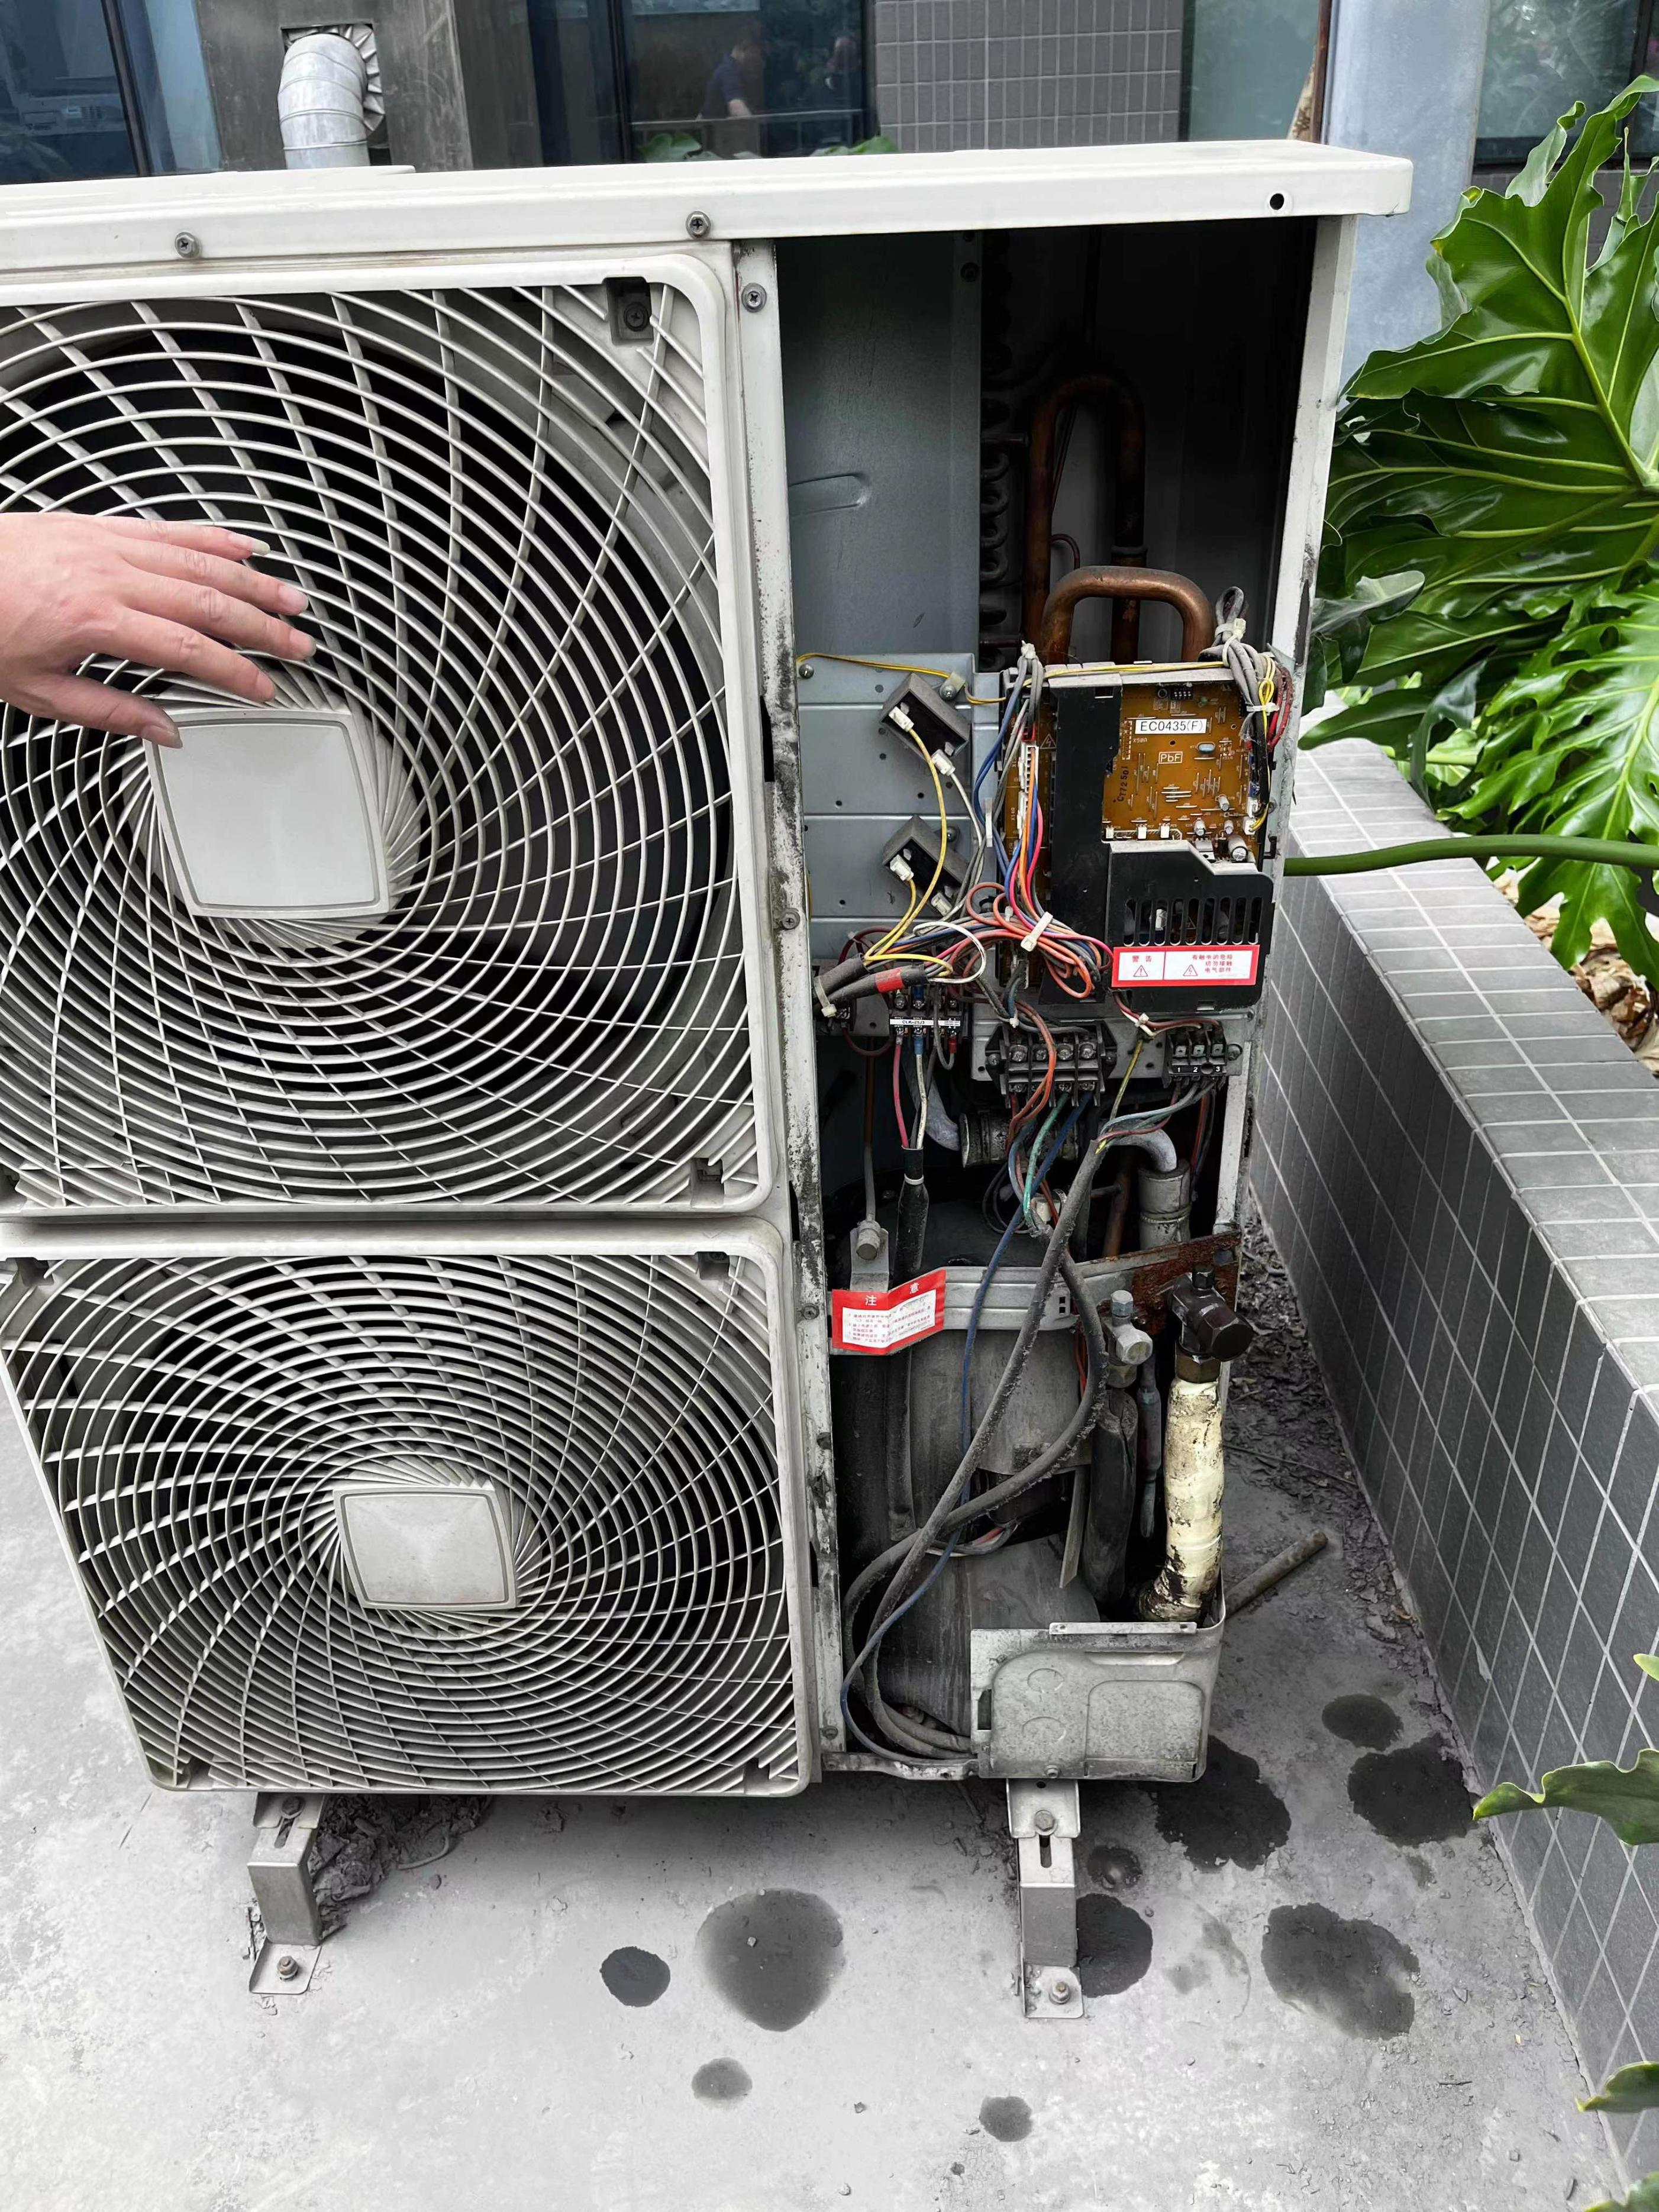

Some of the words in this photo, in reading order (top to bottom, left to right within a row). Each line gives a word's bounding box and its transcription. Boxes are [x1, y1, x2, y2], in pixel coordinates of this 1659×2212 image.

[1140, 720, 1203, 732] EC0435(F)
[1160, 754, 1182, 762] PbF
[866, 1295, 877, 1306] 注
[910, 1283, 919, 1294] 意
